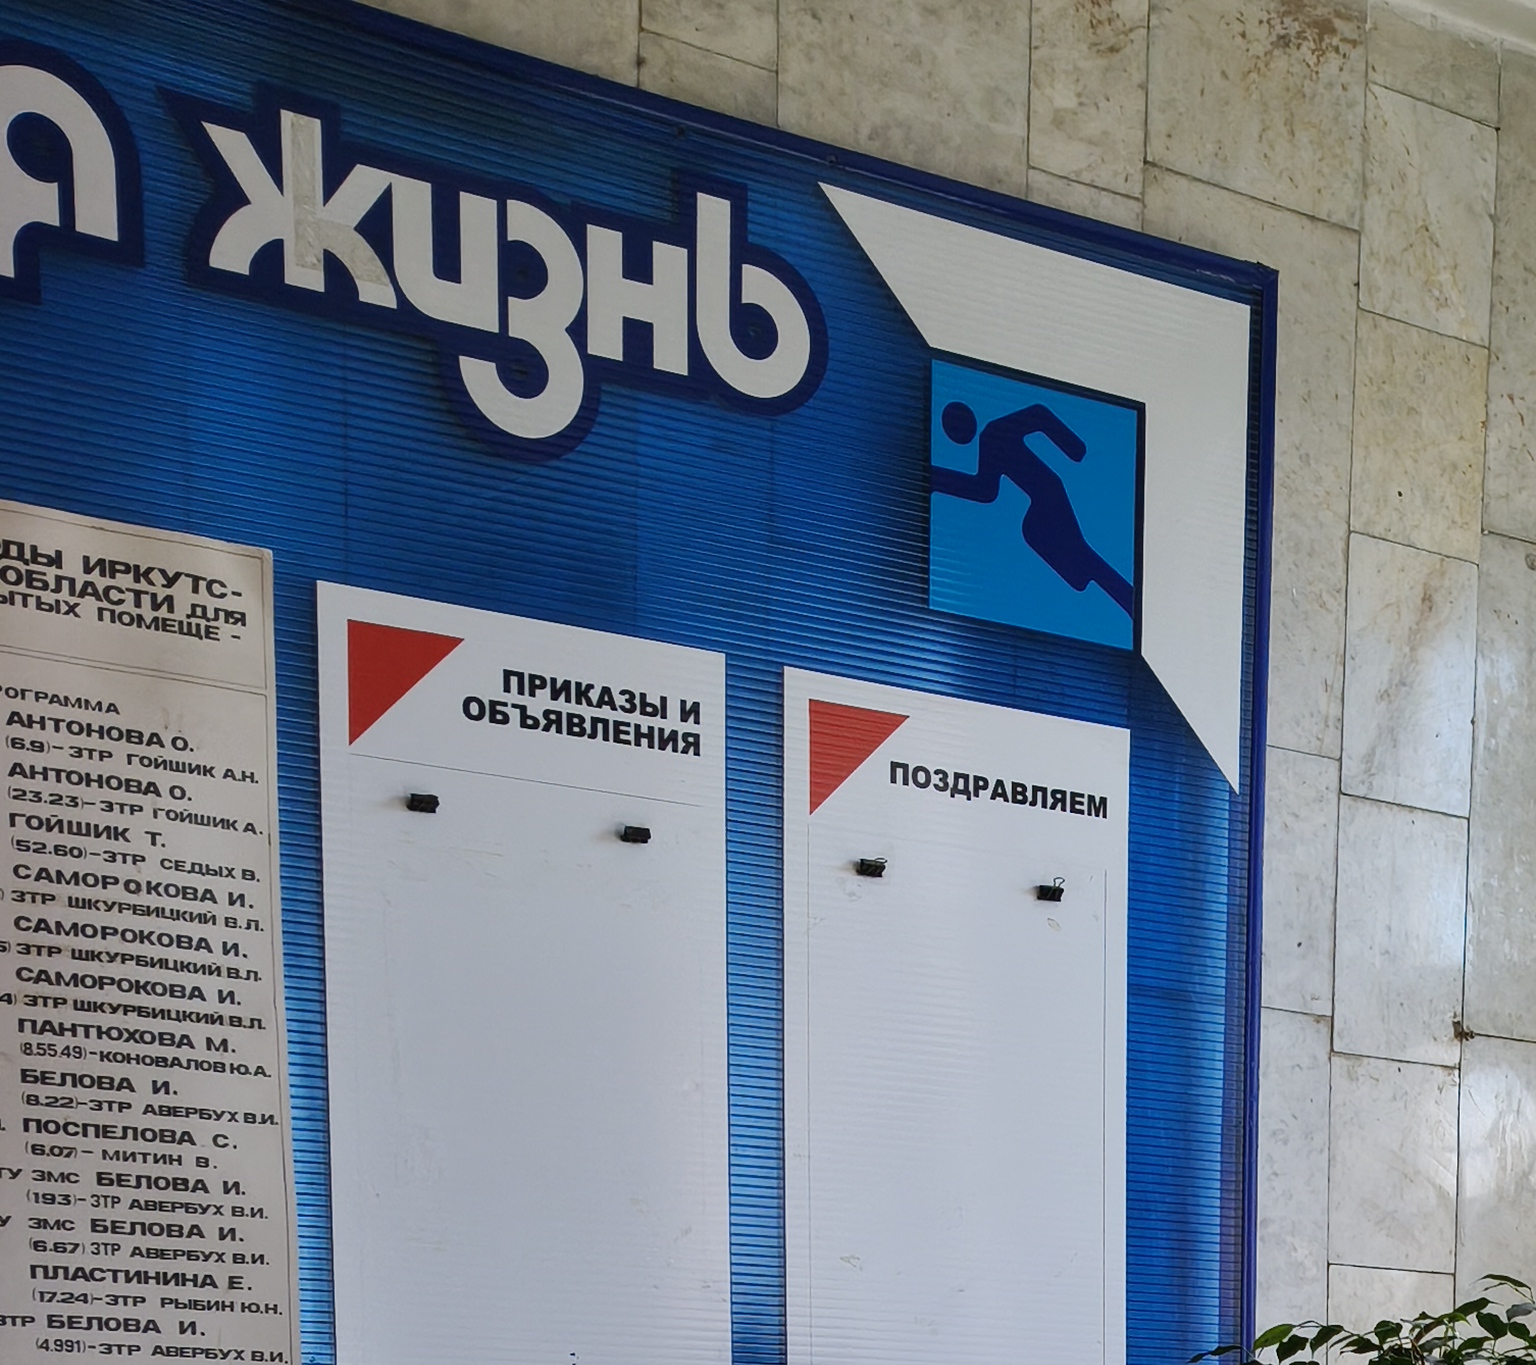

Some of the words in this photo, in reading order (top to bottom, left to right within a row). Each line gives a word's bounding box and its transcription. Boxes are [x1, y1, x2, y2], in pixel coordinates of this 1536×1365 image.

[82, 554, 243, 599] ИРКУТС-
[0, 564, 175, 614] ОБЛАСТИ
[186, 603, 247, 627] ДЛЯ
[0, 685, 120, 715] ОГРАММА
[502, 668, 668, 720] ПРИКАЗЫ
[679, 698, 701, 725] И
[6, 711, 165, 748] АНТОНОВА
[171, 735, 194, 752] О.
[462, 695, 701, 757] ОБЪЯВЛЕНИЯ
[8, 762, 162, 798] АНТОНОВА
[169, 784, 192, 802] О.
[126, 753, 216, 779] ГОЙШИК
[222, 768, 259, 784] А.Н.
[889, 760, 1108, 819] ПОЗДРАВЛЯЕМ
[9, 812, 131, 843] ГОЙШИК
[144, 830, 166, 848] Т.
[153, 807, 238, 832] ГОЙШИК
[242, 822, 263, 835] А.
[160, 858, 237, 880] СЕДЫХ
[242, 868, 260, 882] В.
[12, 863, 218, 905] САМОРОКОВА
[228, 892, 254, 909] И.
[68, 896, 217, 927] ШКУРБИЦКИЙ
[224, 916, 264, 932] В.Л.
[14, 915, 214, 954] САМОРОКОВА
[222, 941, 248, 959] И.
[71, 948, 221, 978] ШКУРБИЦКИЙ
[226, 966, 262, 982] В.Л.
[16, 966, 207, 1002] САМОРОКОВА
[217, 988, 241, 1006] И.
[73, 998, 225, 1027] ШКУРБИЦКИЙ
[229, 1015, 266, 1030] В.Л.
[18, 1018, 196, 1050] ПАНТЮХОВА
[205, 1036, 236, 1053] М.
[20, 1068, 137, 1093] БЕЛОВА
[151, 1079, 178, 1095] И.
[229, 1062, 272, 1078] Ю.А.
[142, 1103, 239, 1123] АВЕРБУХ
[243, 1112, 279, 1126] В.И.
[23, 1117, 197, 1146] ПОСПЕЛОВА
[212, 1133, 238, 1150] С.
[101, 1148, 183, 1166] МИТИН
[195, 1156, 218, 1170] В.
[96, 1171, 211, 1194] БЕЛОВА
[222, 1180, 246, 1196] И.
[128, 1198, 225, 1217] АВЕРБУХ
[231, 1205, 269, 1220] В.И.
[90, 1217, 206, 1239] БЕЛОВА
[218, 1226, 245, 1242] И.
[129, 1246, 226, 1263] АВЕРБУХ
[232, 1252, 270, 1266] В.И.
[30, 1264, 219, 1290] ПЛАСТИНИНА
[228, 1275, 252, 1290] Е.
[160, 1297, 235, 1312] РЫБИН
[240, 1302, 283, 1316] Ю.Н.
[46, 1313, 162, 1334] БЕЛОВА
[178, 1320, 206, 1337] И.
[151, 1345, 246, 1361] АВЕРБУХ
[251, 1350, 289, 1364] В.И.
